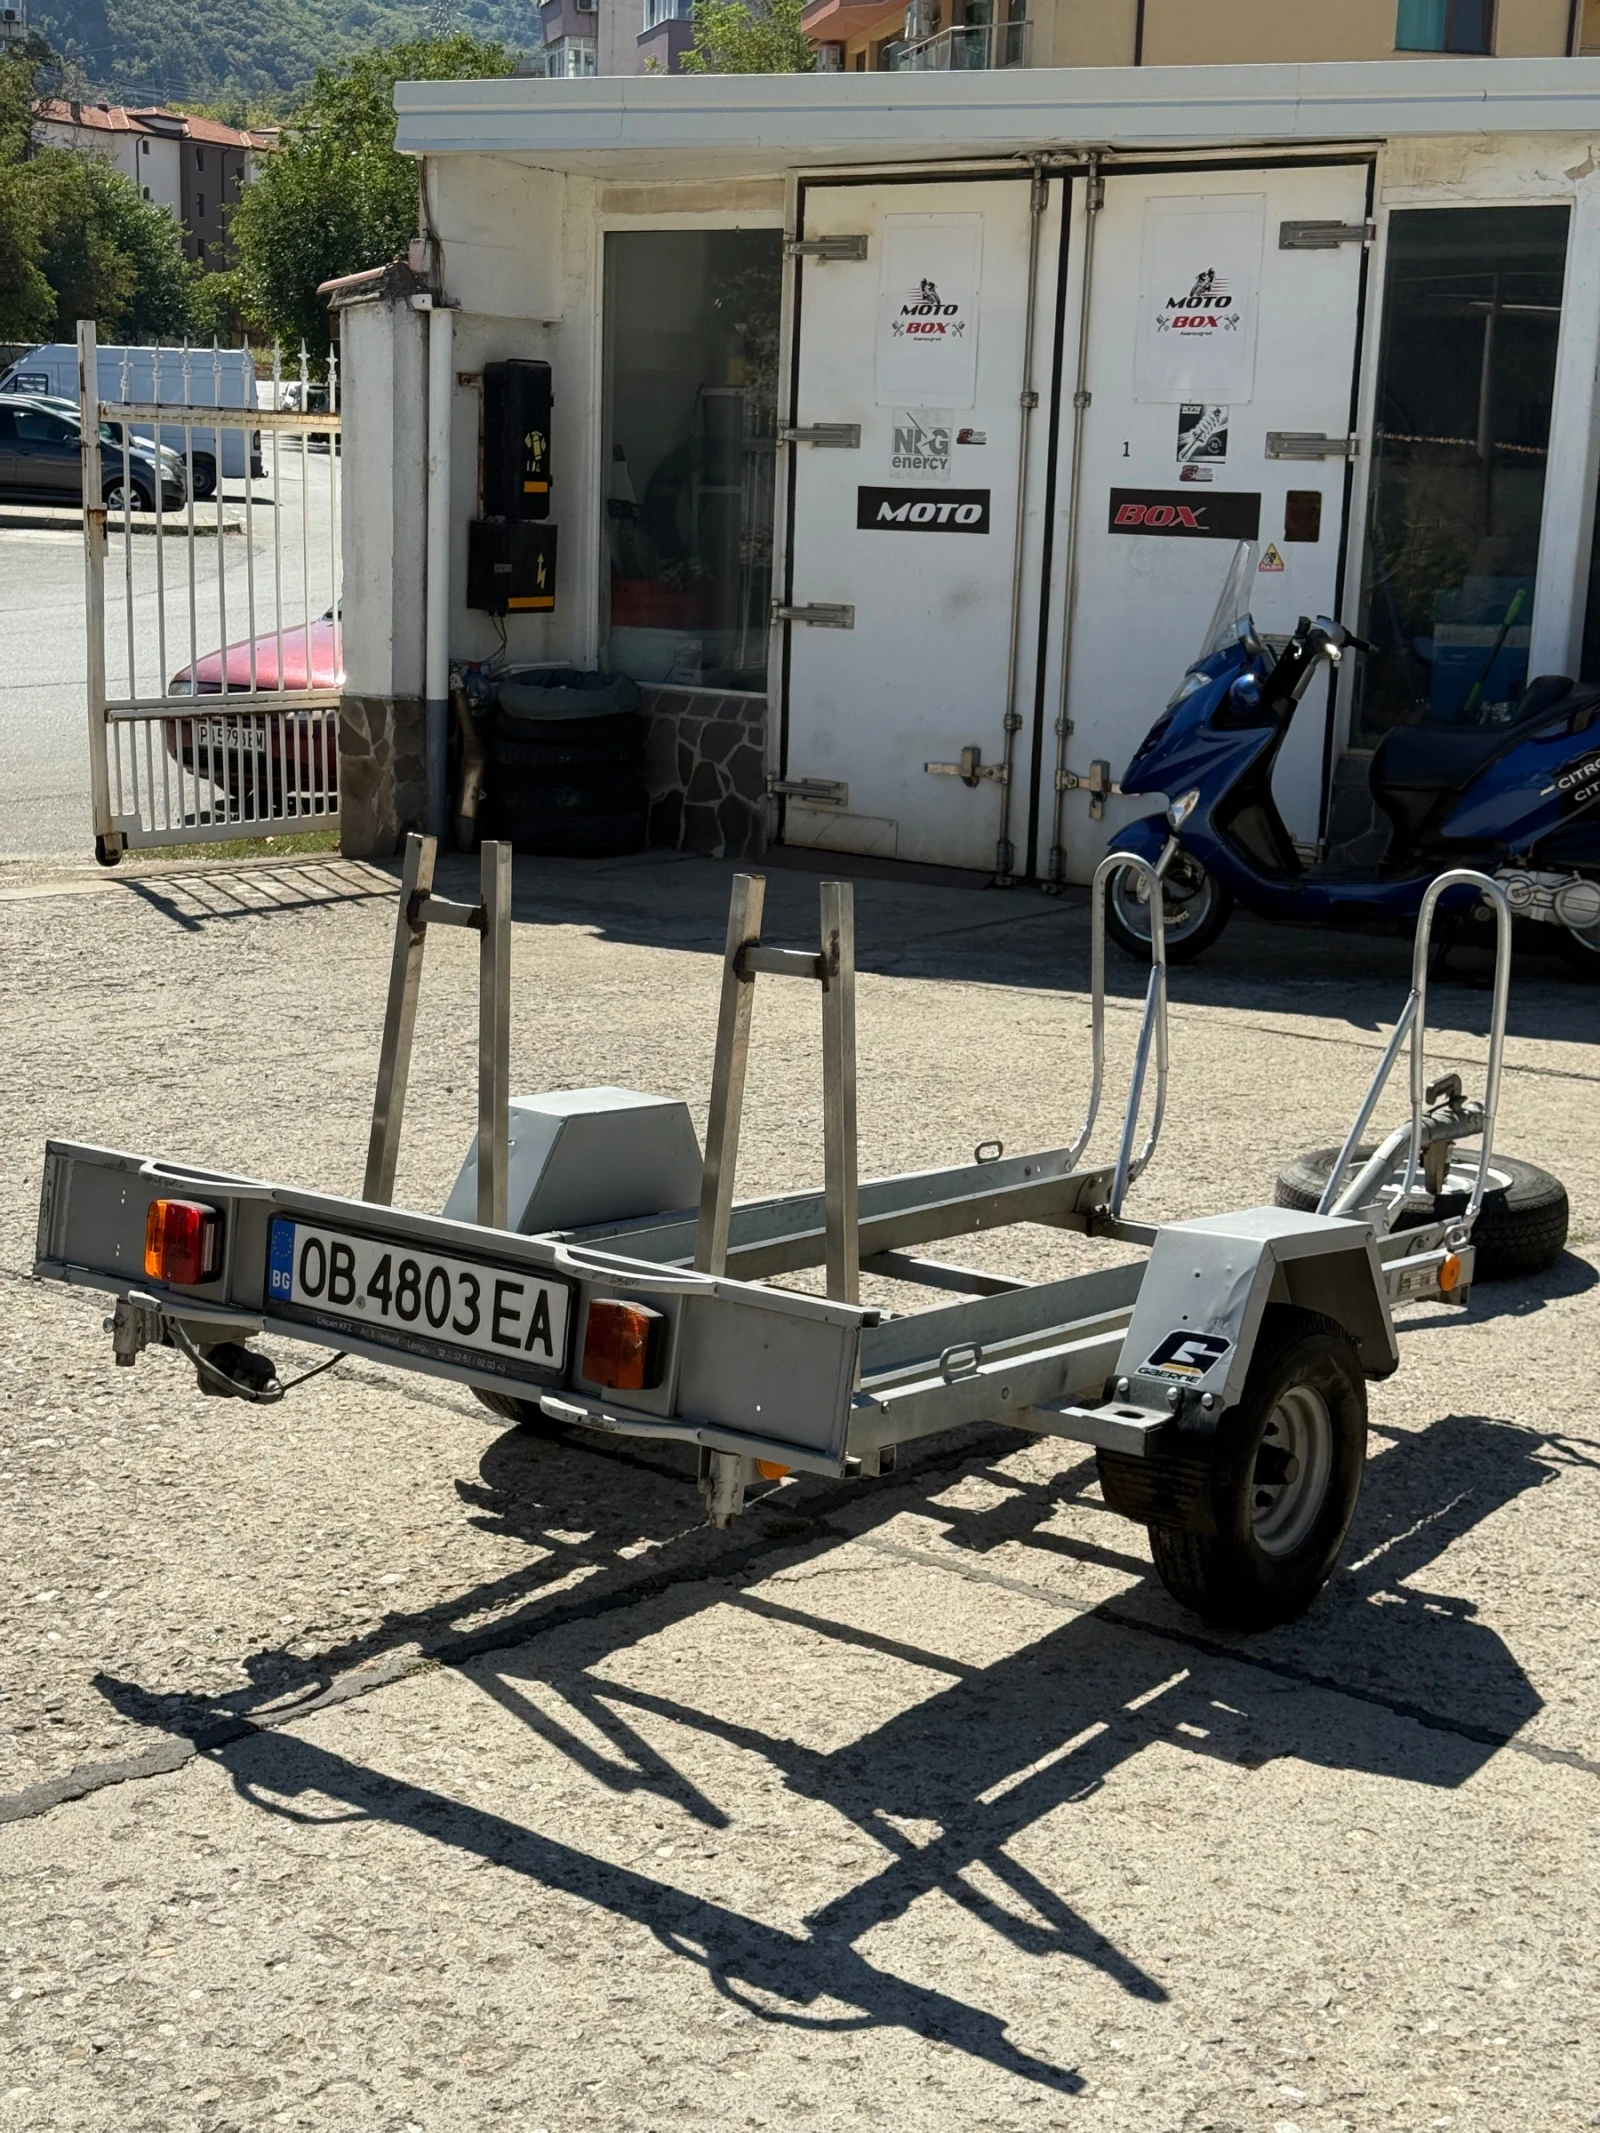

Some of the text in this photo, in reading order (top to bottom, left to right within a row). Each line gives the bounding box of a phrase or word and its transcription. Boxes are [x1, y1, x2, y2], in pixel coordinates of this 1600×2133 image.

[900, 304, 959, 316] MOTO
[1165, 296, 1232, 309] MOTO
[905, 322, 951, 334] BOX
[1171, 315, 1223, 328] BOX
[1122, 441, 1131, 457] 1
[876, 501, 983, 524] MOTO
[1114, 504, 1207, 528] BOX
[272, 1269, 291, 1291] BG
[366, 1254, 481, 1336] 4803
[491, 1279, 554, 1357] EA
